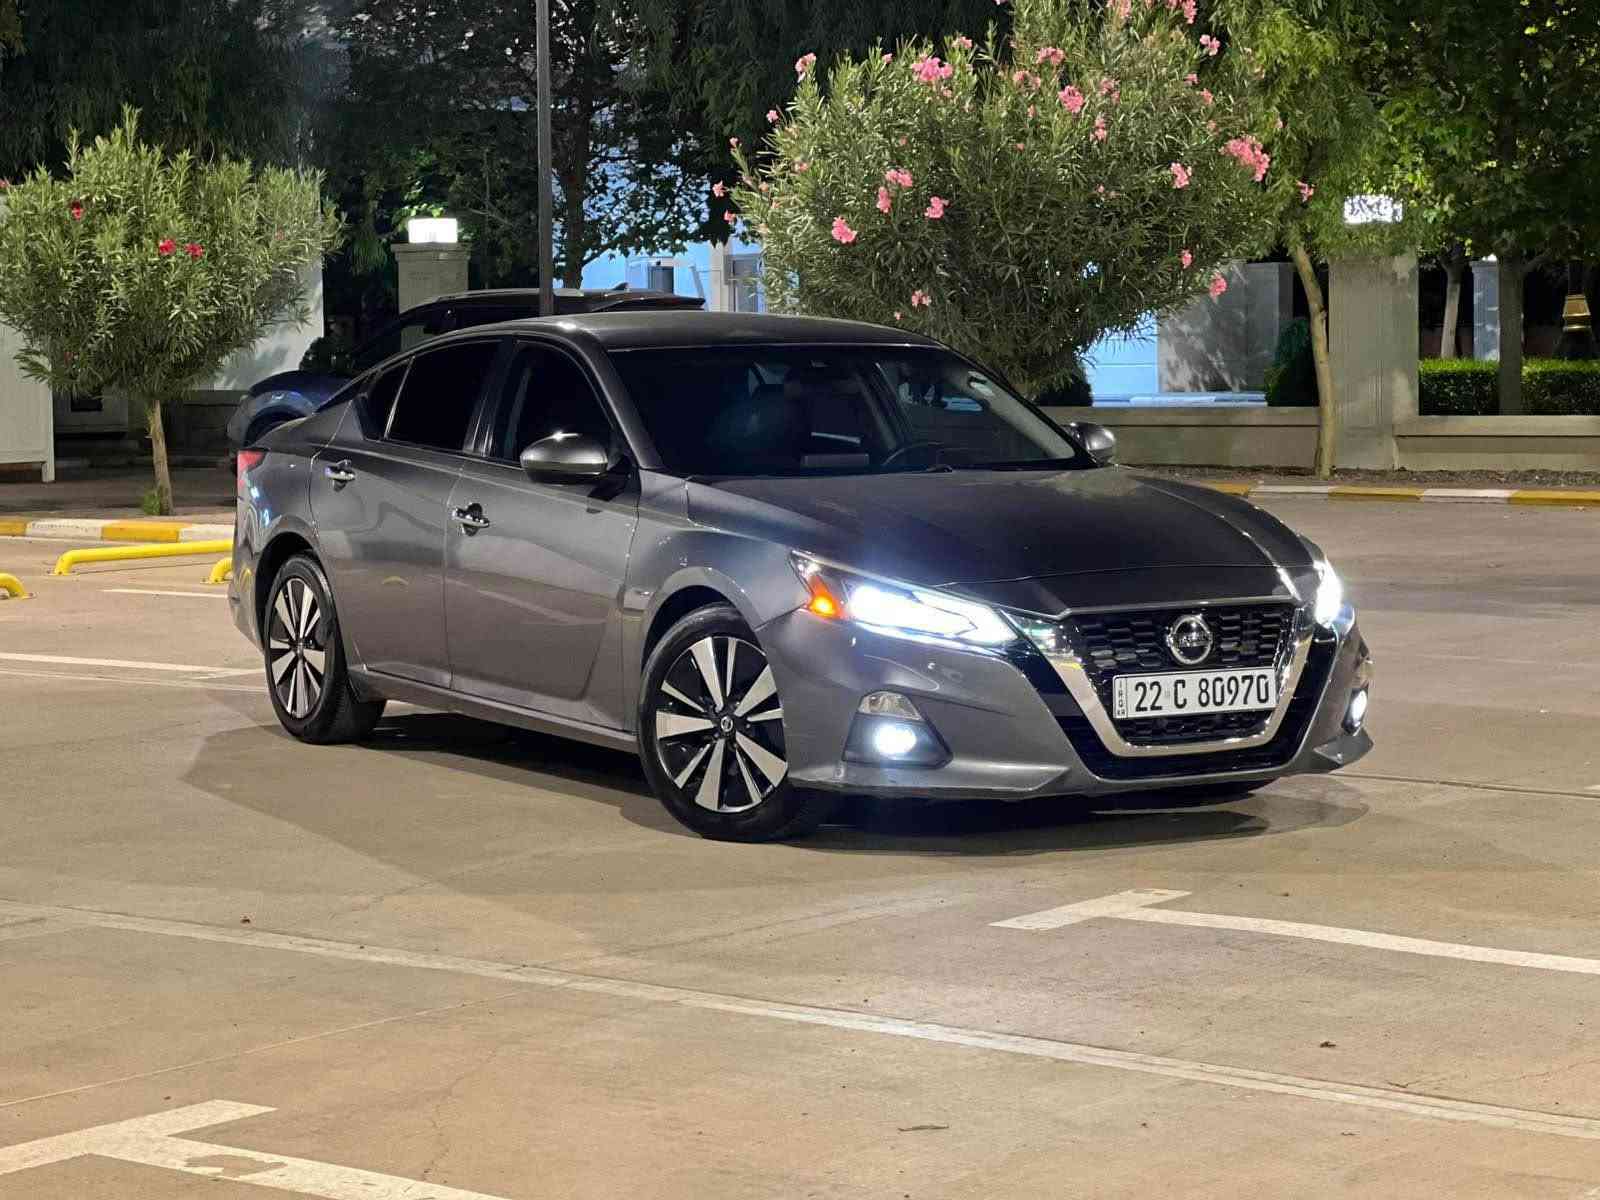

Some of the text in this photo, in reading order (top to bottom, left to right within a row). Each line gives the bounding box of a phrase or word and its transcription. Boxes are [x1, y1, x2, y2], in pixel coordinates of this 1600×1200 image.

[1135, 674, 1269, 712] 22 C 80970
